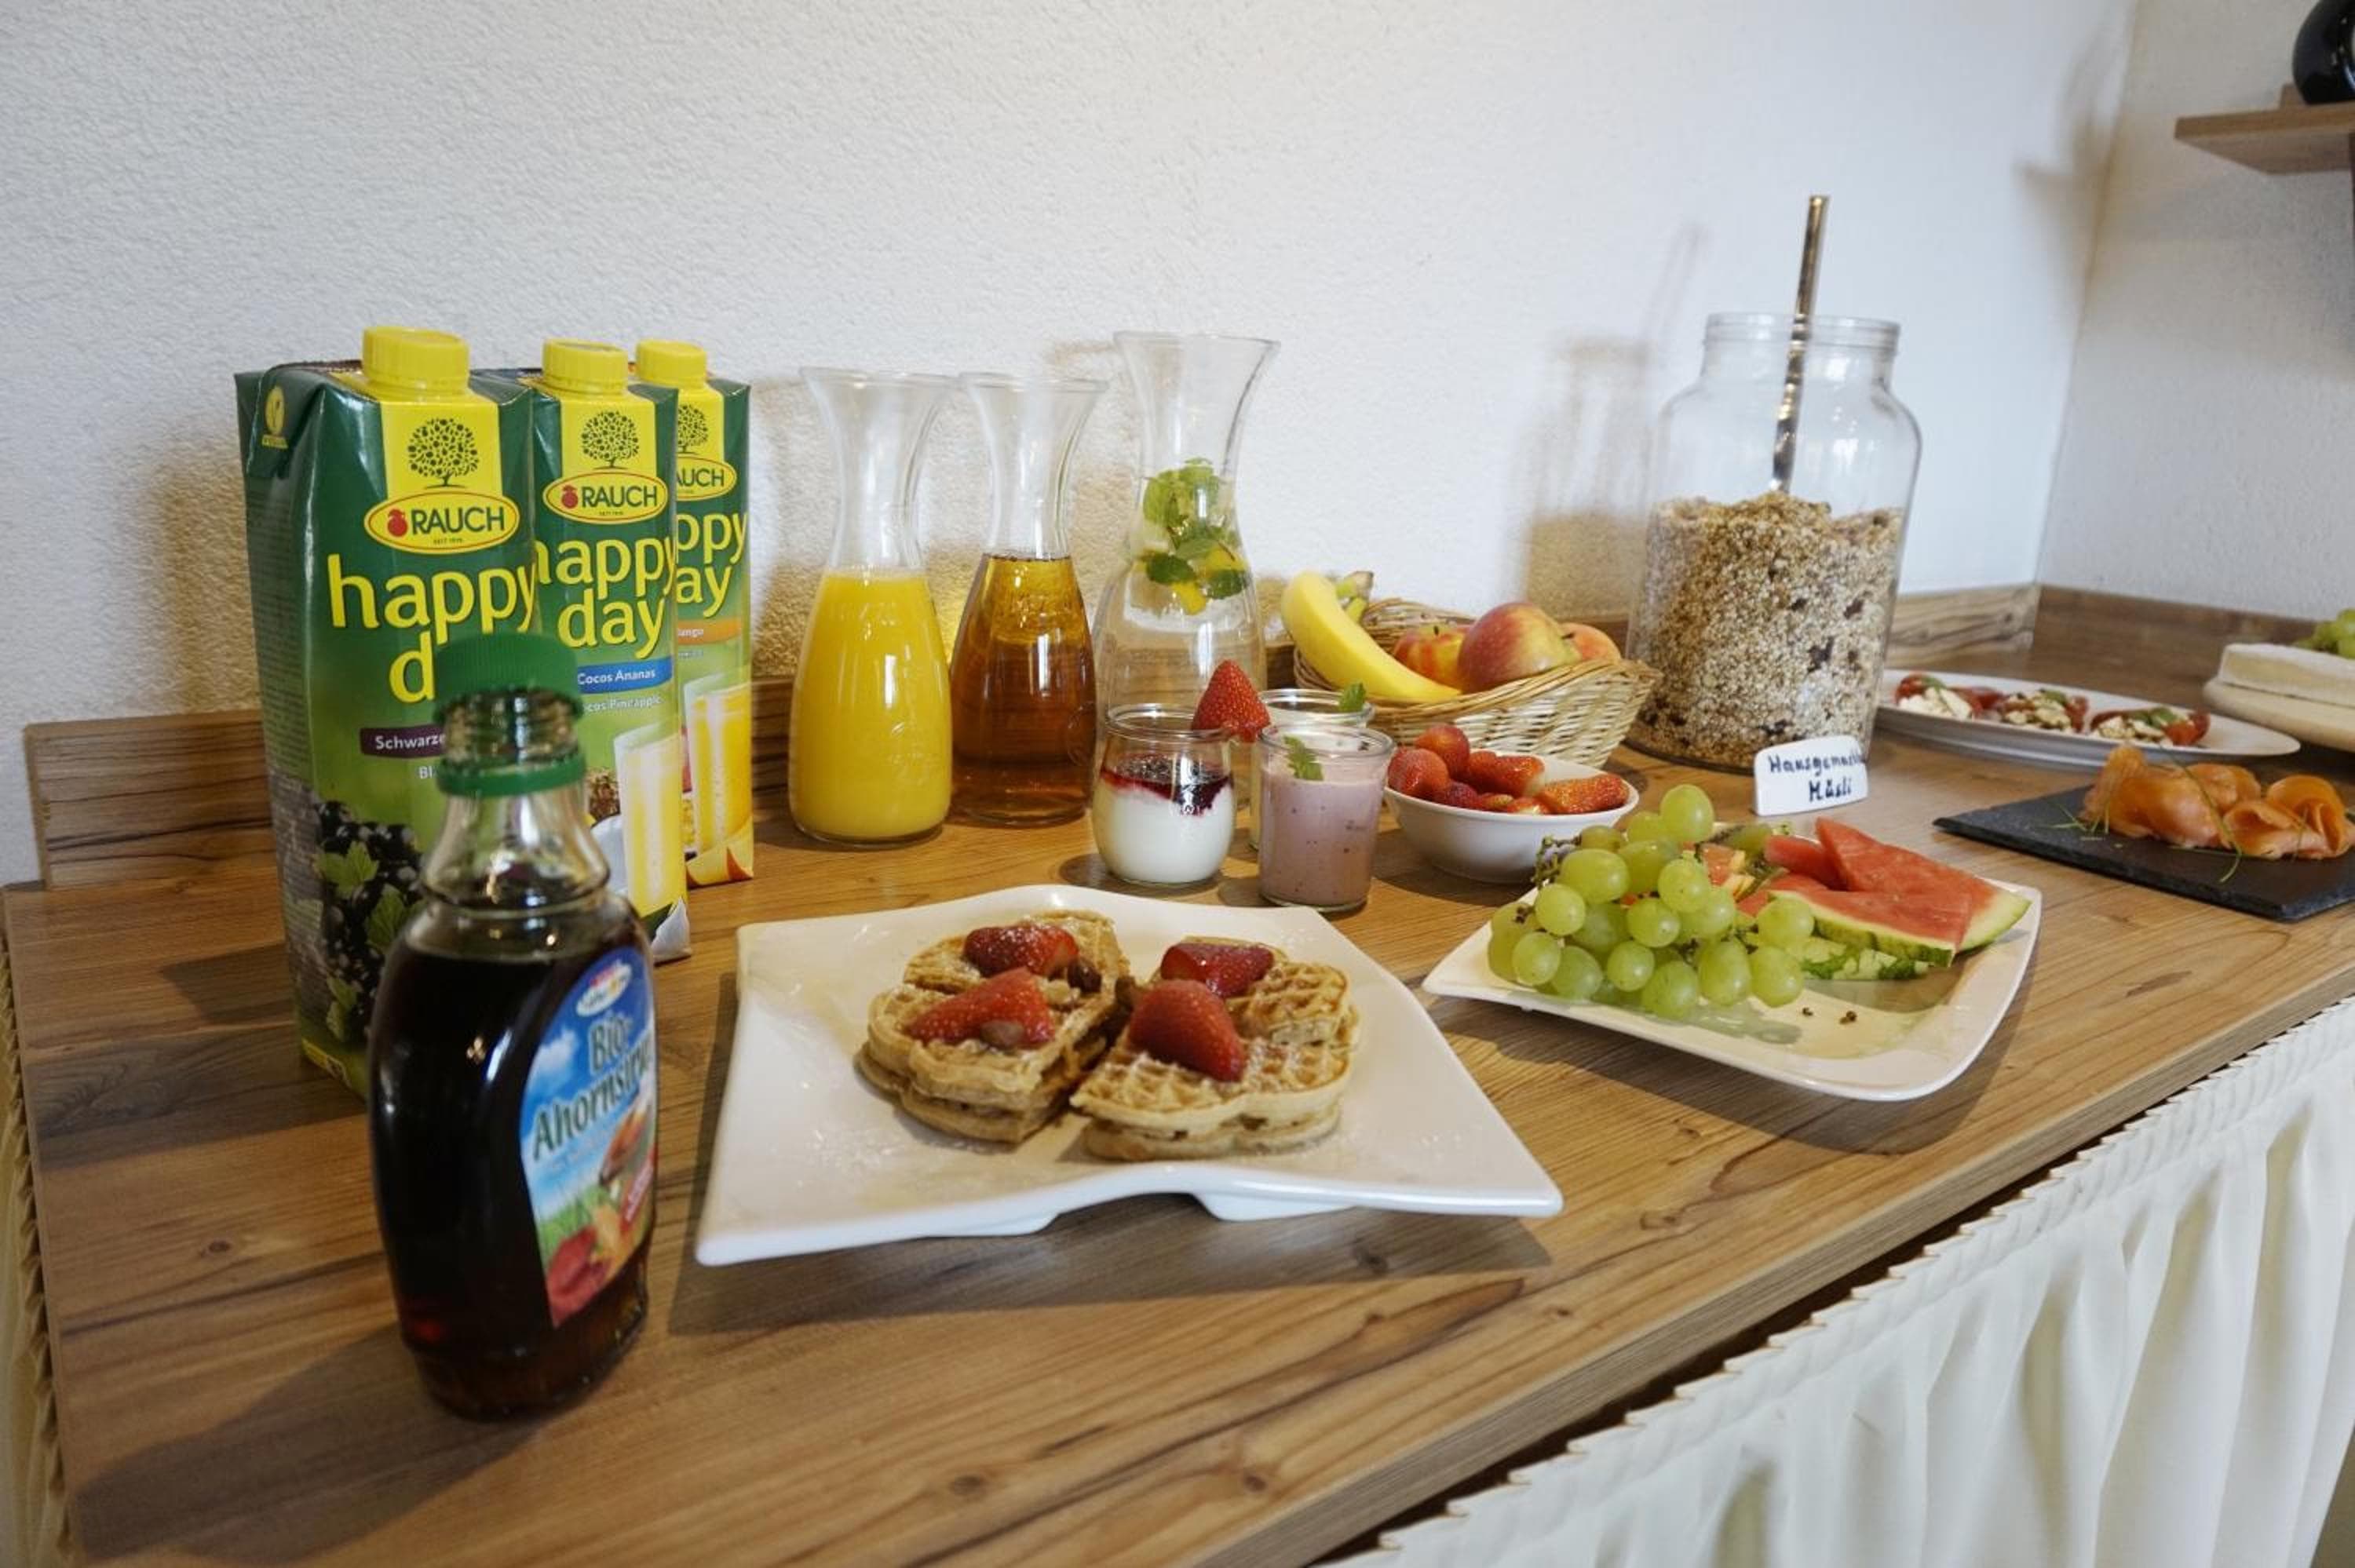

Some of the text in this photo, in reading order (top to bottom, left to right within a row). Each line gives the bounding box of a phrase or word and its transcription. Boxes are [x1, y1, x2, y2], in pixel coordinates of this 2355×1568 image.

[677, 468, 725, 487] UCH
[582, 485, 658, 507] RAUCH
[411, 506, 505, 535] RAUCH
[677, 512, 749, 564] ppy
[327, 553, 536, 644] happy
[677, 566, 732, 618] ay
[558, 588, 666, 659] day
[577, 669, 656, 685] Cocos Ananas
[1808, 777, 1852, 803] Müsli
